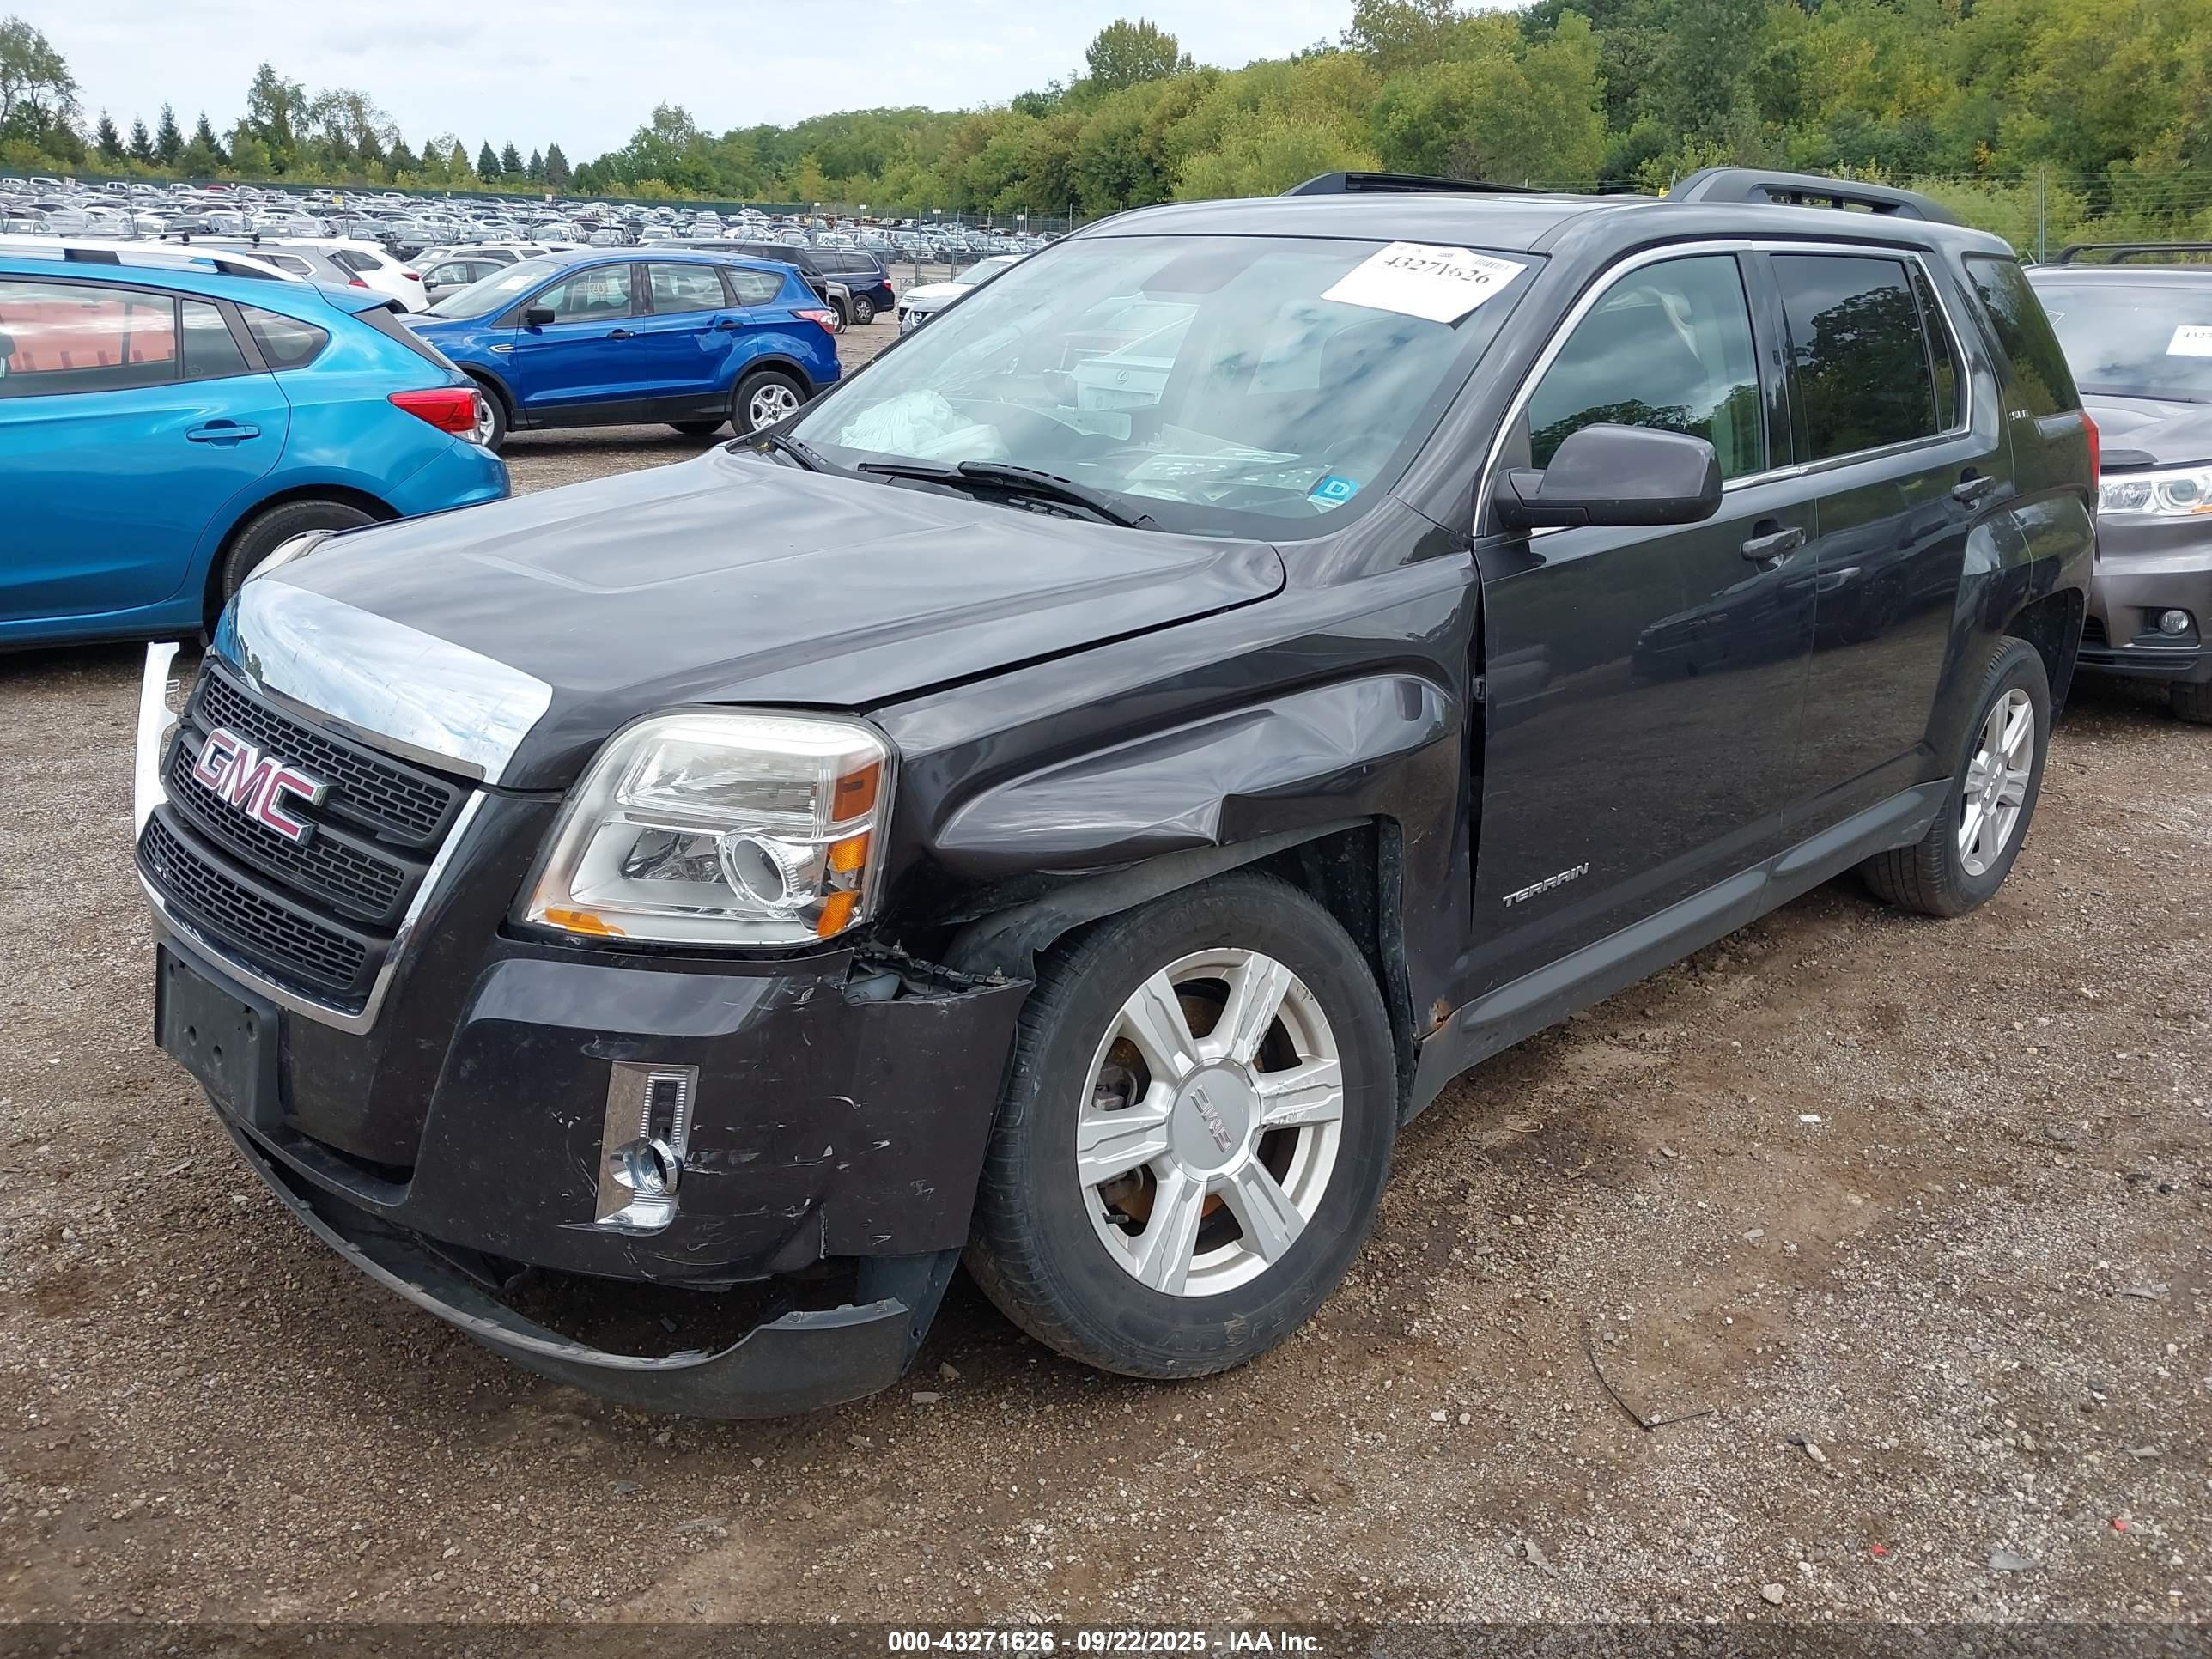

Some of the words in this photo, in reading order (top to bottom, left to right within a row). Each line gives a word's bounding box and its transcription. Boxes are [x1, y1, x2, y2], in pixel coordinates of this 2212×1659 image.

[1383, 256, 1491, 284] 43271626
[1323, 480, 1350, 496] D
[193, 727, 326, 842] GMC
[1503, 862, 1589, 908] TERRAIN
[1189, 1085, 1231, 1152] GMC
